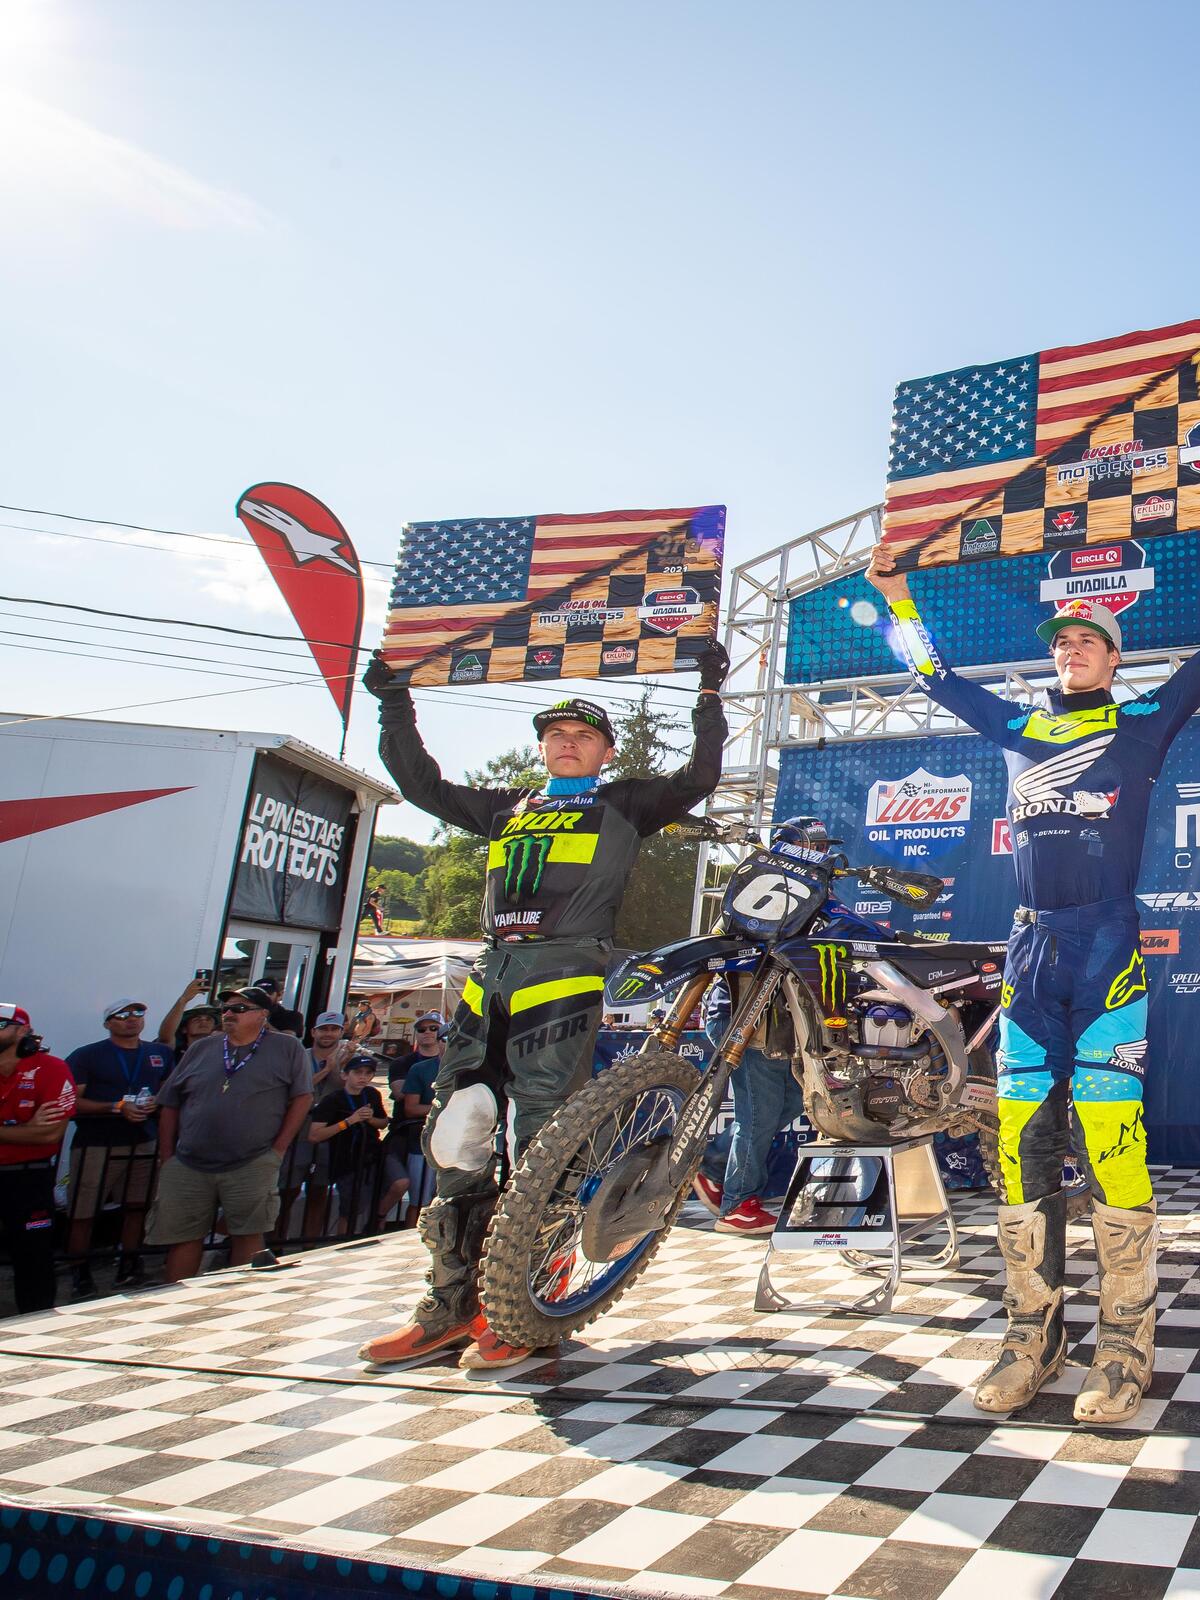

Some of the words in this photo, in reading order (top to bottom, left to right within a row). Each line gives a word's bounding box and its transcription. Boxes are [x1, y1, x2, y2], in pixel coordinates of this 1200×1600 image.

[1082, 442, 1120, 460] LUCAS
[1122, 440, 1144, 453] OIL
[1058, 452, 1168, 481] MOTOCROSS
[1137, 502, 1172, 515] EKLUND
[1075, 553, 1104, 564] CIRCLE
[1107, 551, 1117, 561] K
[663, 565, 688, 573] 2021
[1066, 576, 1127, 594] UNADILLA
[559, 600, 590, 610] LUCAS
[592, 599, 607, 608] OIL
[652, 606, 688, 615] UNADILLA
[539, 611, 624, 624] MOTOCROSS
[606, 652, 632, 660] EKLUND
[910, 617, 947, 681] HONDA
[923, 786, 970, 796] PERFORMANCE
[876, 794, 967, 824] LUCAS
[1012, 799, 1109, 823] HOND
[501, 811, 584, 835] THOR
[868, 830, 891, 842] OIL
[895, 826, 966, 840] PRODUCTS
[1038, 829, 1071, 837] DUNLOP
[903, 845, 930, 856] INC.
[767, 858, 792, 871] LUCAS
[793, 865, 807, 876] OIL
[733, 874, 811, 920] 6
[855, 901, 892, 914] WPS
[494, 910, 542, 928] YAMALUBE
[913, 911, 941, 922] guaranteed
[852, 942, 877, 953] YAMALUBE
[1141, 936, 1169, 948] KTM
[631, 972, 652, 982] YAMAHA
[664, 972, 691, 987] SPECIALIZED
[759, 969, 779, 1001] racing
[827, 1018, 845, 1026] FMF
[513, 1014, 588, 1058] THOR
[1109, 1057, 1145, 1075] HONDA
[682, 1093, 700, 1121] CYCRA
[671, 1083, 713, 1164] DUNLOP
[813, 1238, 848, 1246] MOTOCROSS
